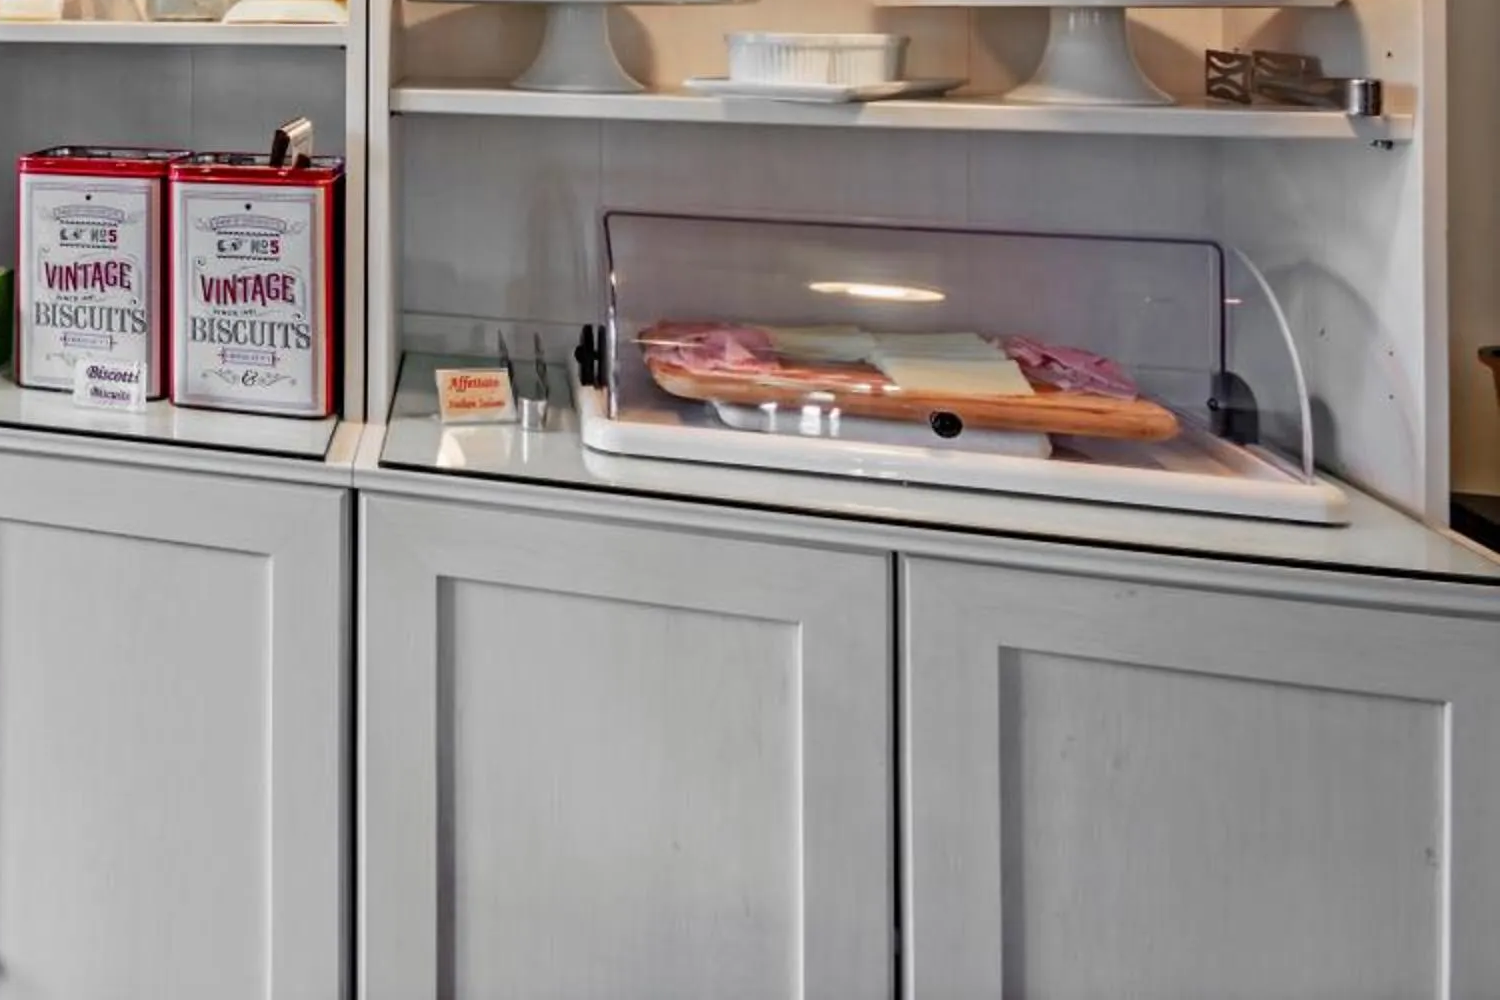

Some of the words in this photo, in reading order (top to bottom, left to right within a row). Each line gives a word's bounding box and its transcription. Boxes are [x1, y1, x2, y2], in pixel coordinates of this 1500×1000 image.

[44, 261, 133, 293] VINTAGE
[200, 273, 296, 307] VINTAGE
[35, 302, 148, 335] BISCUITS
[191, 316, 311, 350] BISCUITS
[86, 365, 140, 384] Biscotti
